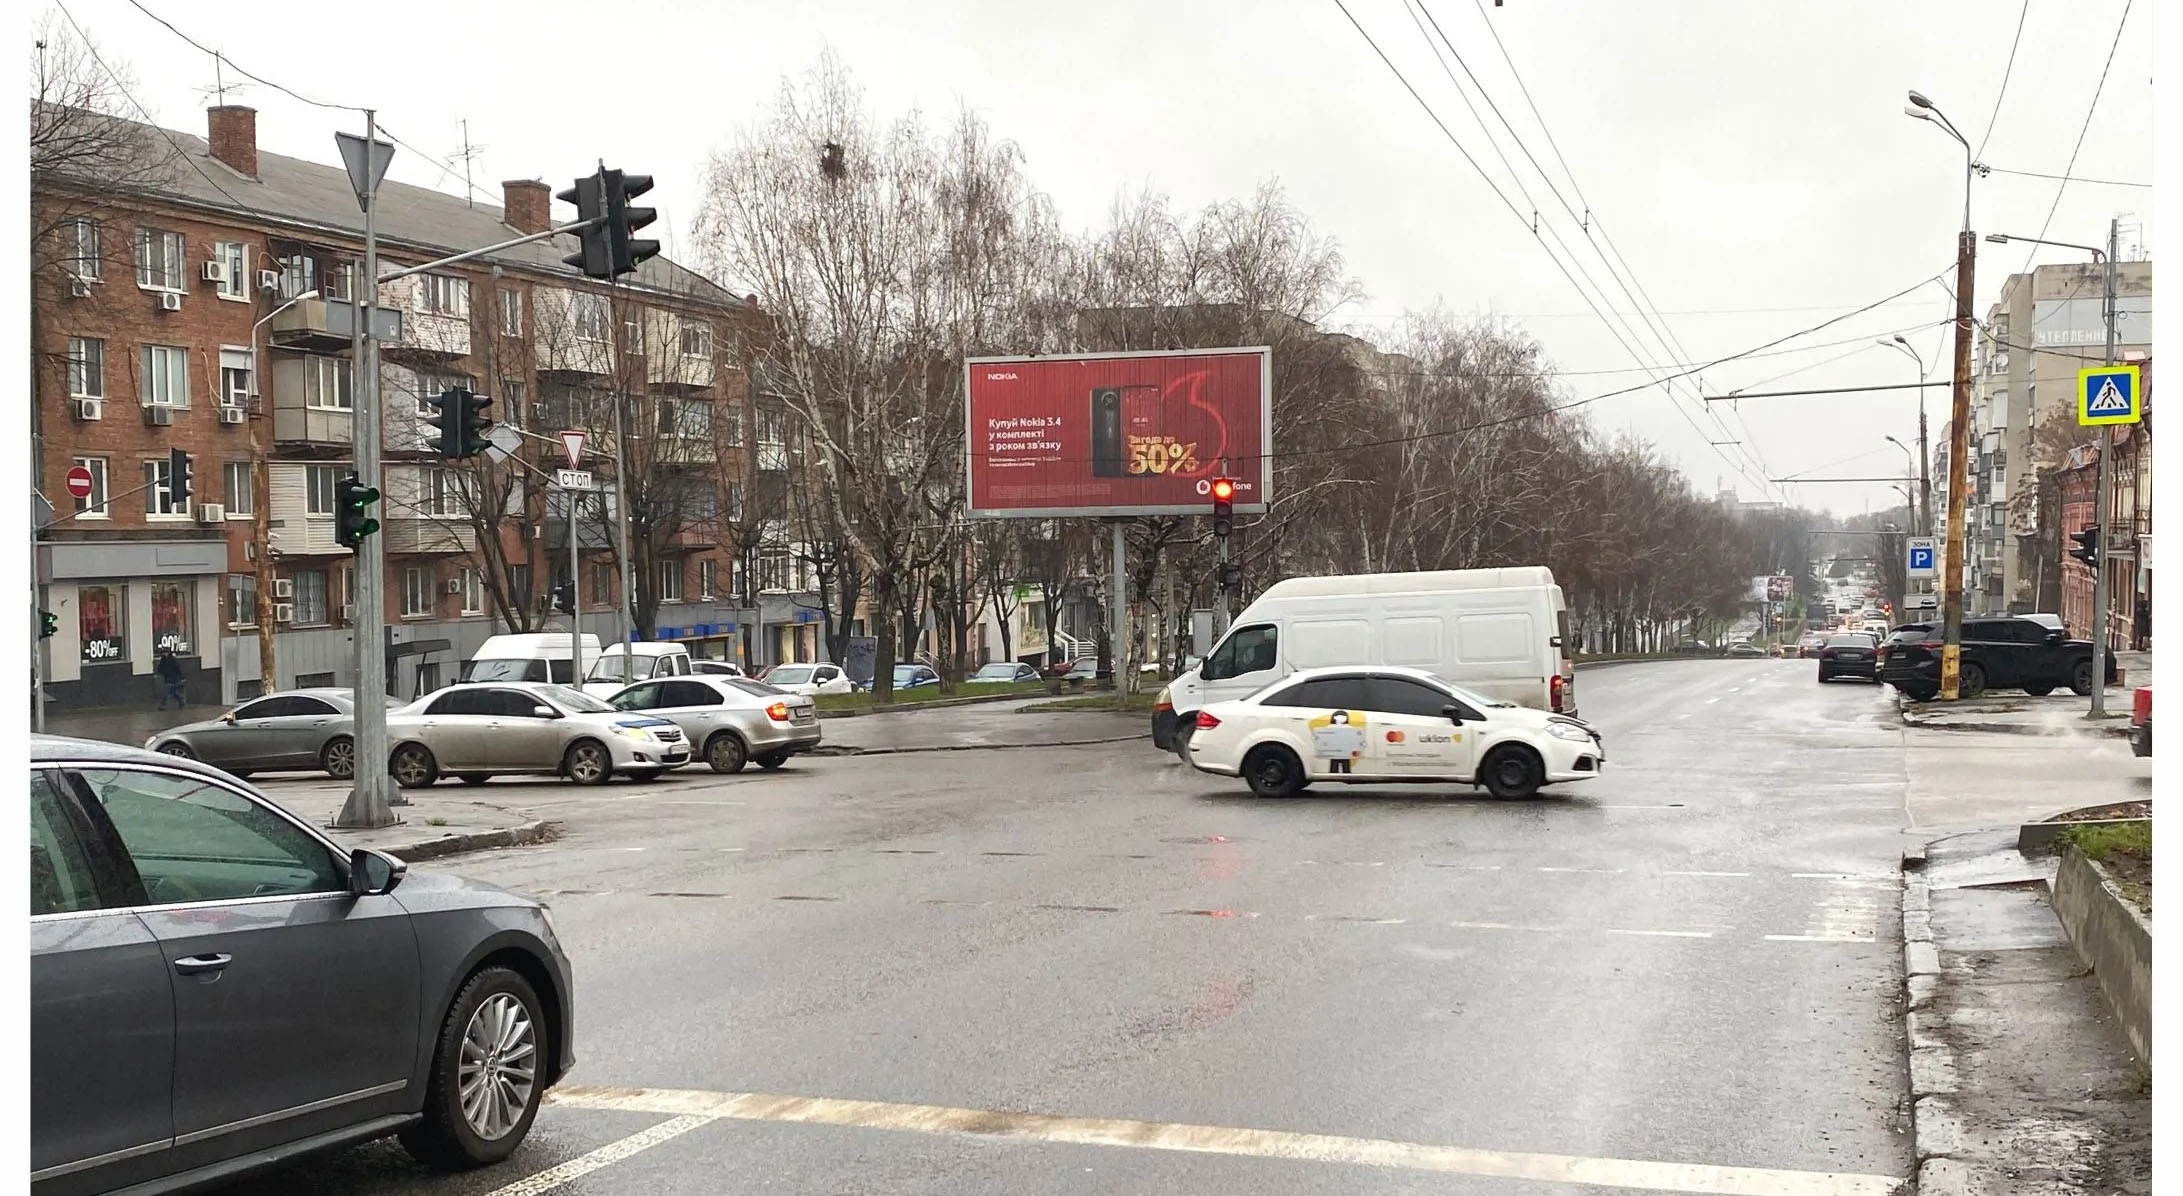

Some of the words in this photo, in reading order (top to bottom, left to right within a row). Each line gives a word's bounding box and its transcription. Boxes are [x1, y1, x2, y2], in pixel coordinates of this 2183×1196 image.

[987, 372, 1019, 381] NOKIA
[988, 417, 1018, 430] Купуй
[1019, 416, 1046, 428] Nokia
[1046, 416, 1061, 427] 3.4
[988, 431, 996, 442] у
[996, 428, 1045, 439] комплекті
[1163, 436, 1176, 444] до
[988, 442, 995, 451] з
[996, 442, 1026, 453] роком
[1026, 440, 1062, 452] зв'язку
[1128, 442, 1200, 474] 50%
[562, 473, 590, 487] СТОП
[1915, 551, 1928, 567] P
[84, 639, 111, 658] -80%
[107, 646, 119, 657] OFF
